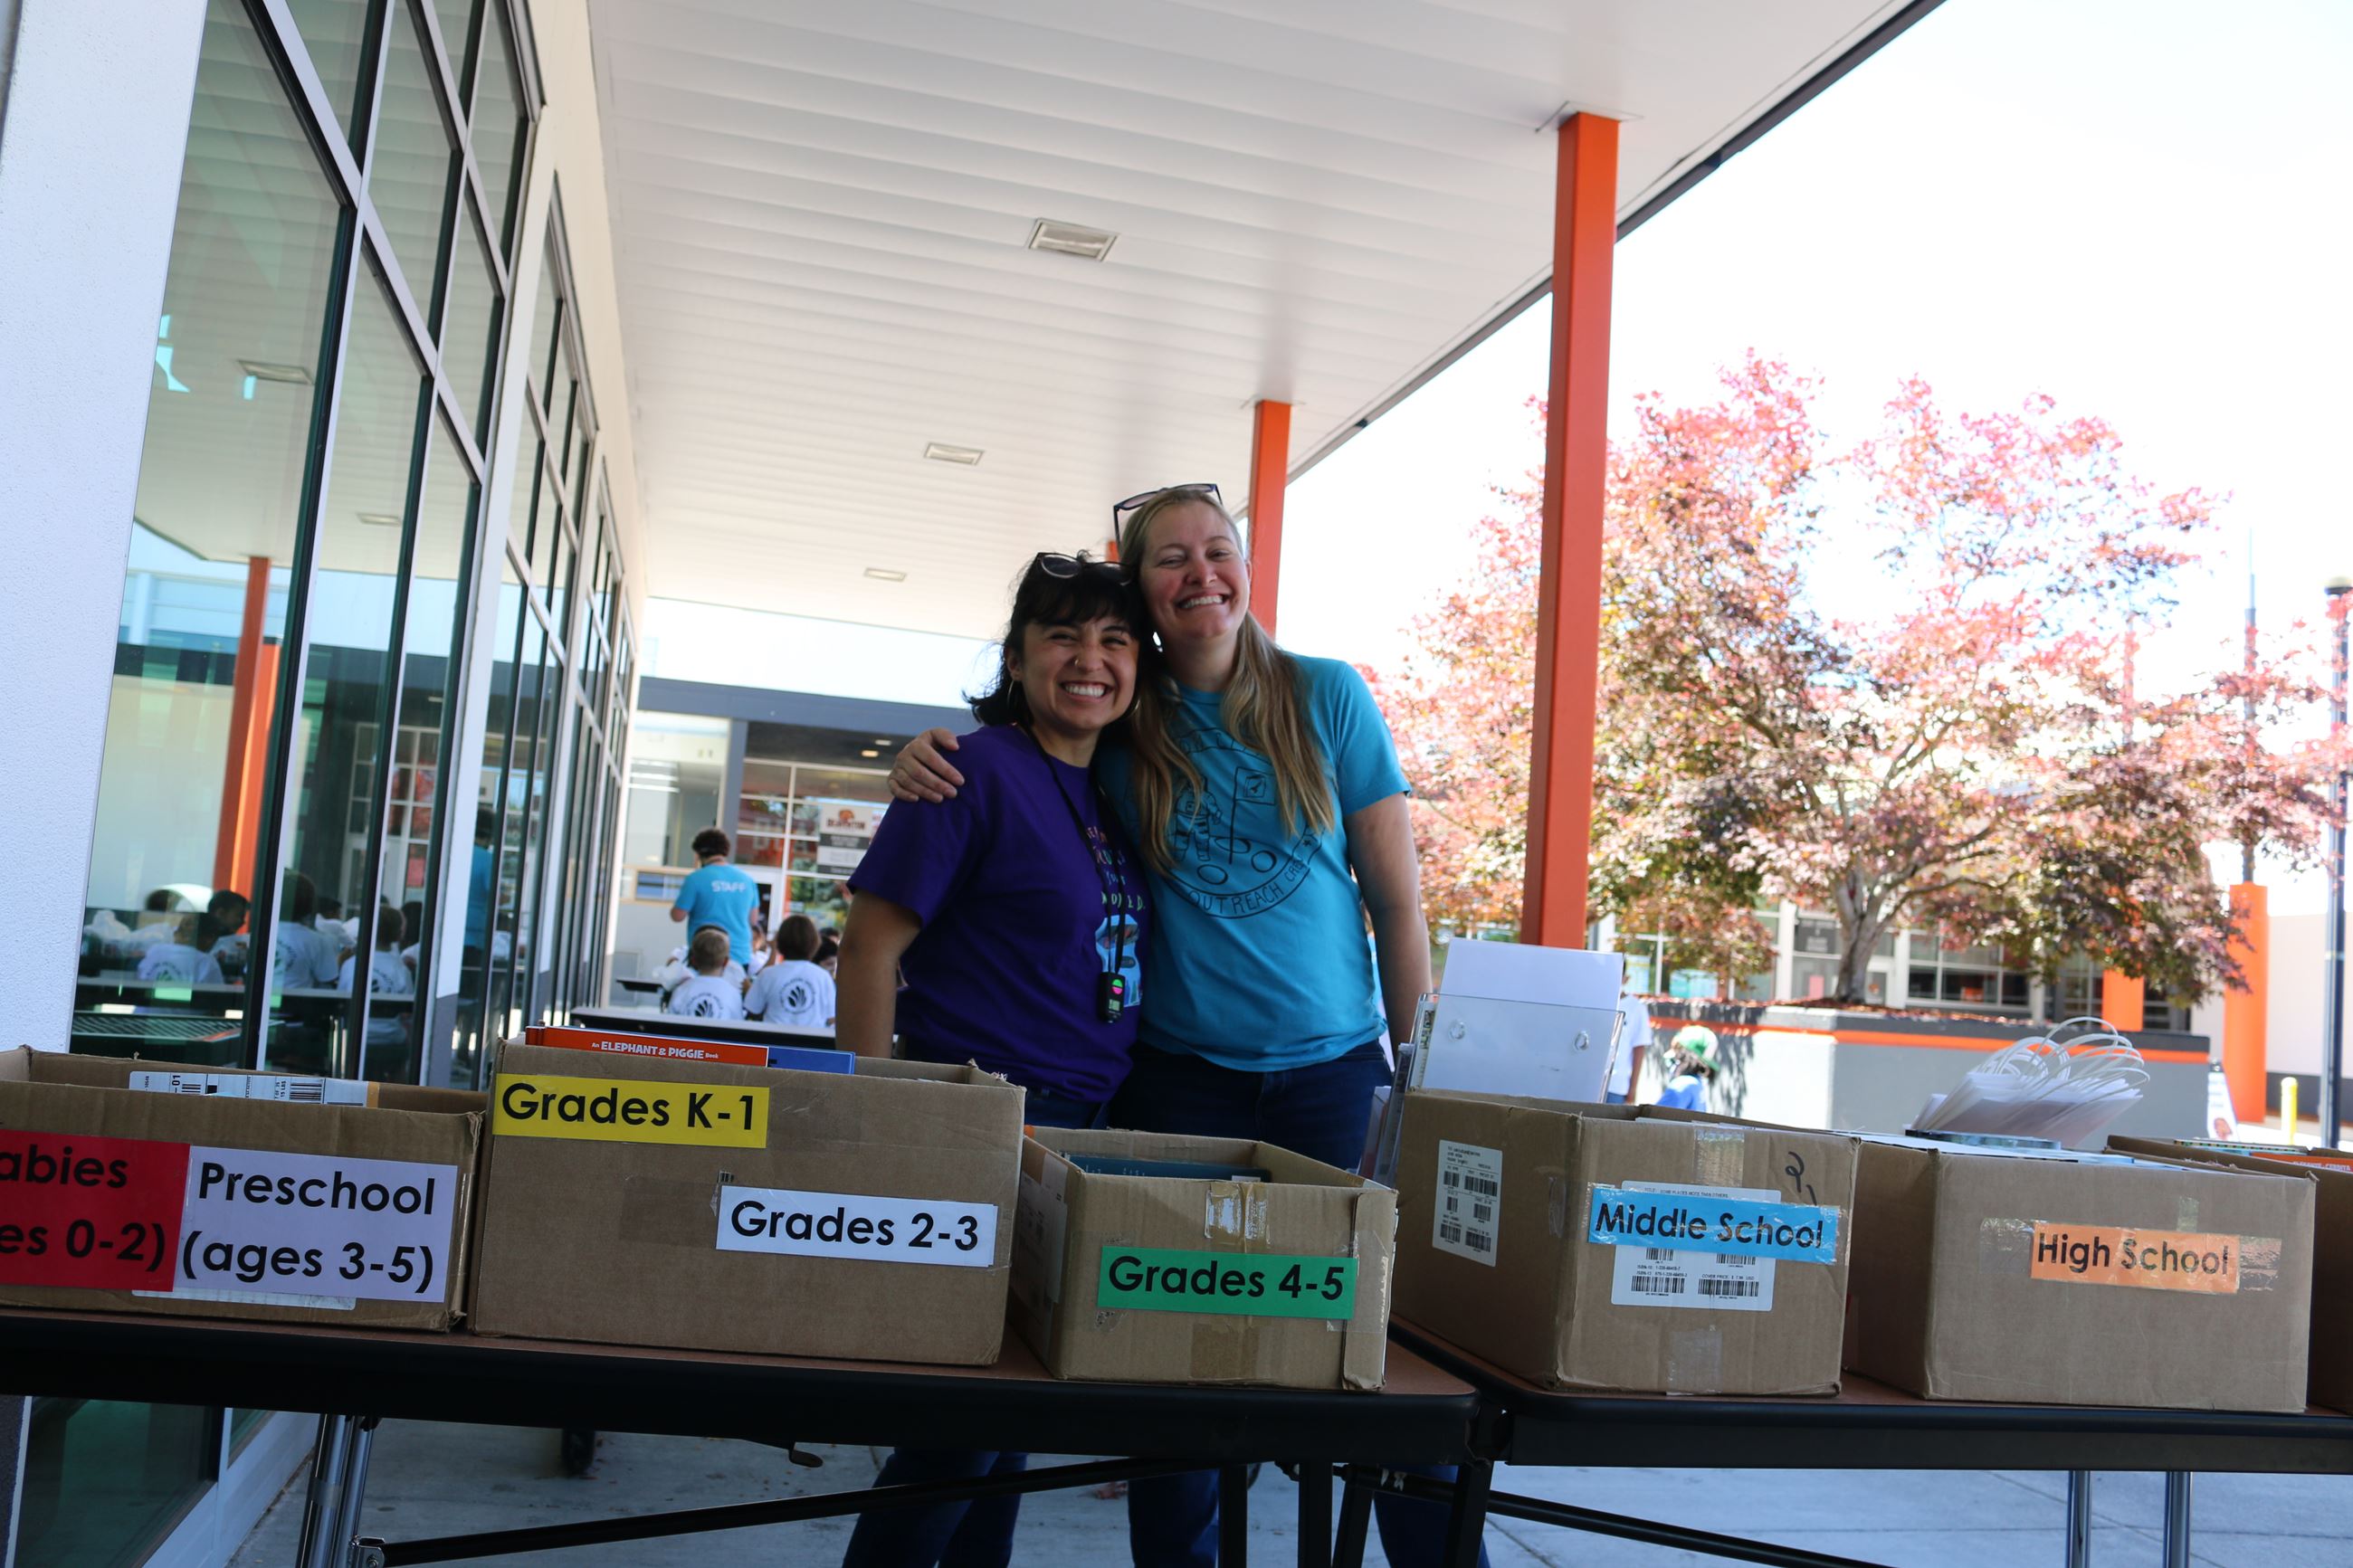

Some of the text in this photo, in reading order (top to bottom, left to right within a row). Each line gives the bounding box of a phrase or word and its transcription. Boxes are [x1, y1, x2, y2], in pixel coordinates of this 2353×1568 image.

[711, 879, 748, 893] STAFF
[1188, 882, 1284, 915] OUTREACH
[601, 1041, 658, 1055] ELEPHANT
[658, 1047, 667, 1056] &
[668, 1047, 704, 1060] PIGGIE
[501, 1082, 754, 1131] Grades K-1
[198, 1162, 435, 1215] Preschool
[66, 1220, 166, 1272] 0-2)
[730, 1200, 979, 1251] Grades 2-3
[1596, 1202, 1824, 1249] Middle School
[182, 1230, 434, 1294] (ages 3-5)
[2038, 1232, 2229, 1275] High School
[1109, 1255, 1346, 1301] Grades 4-5
